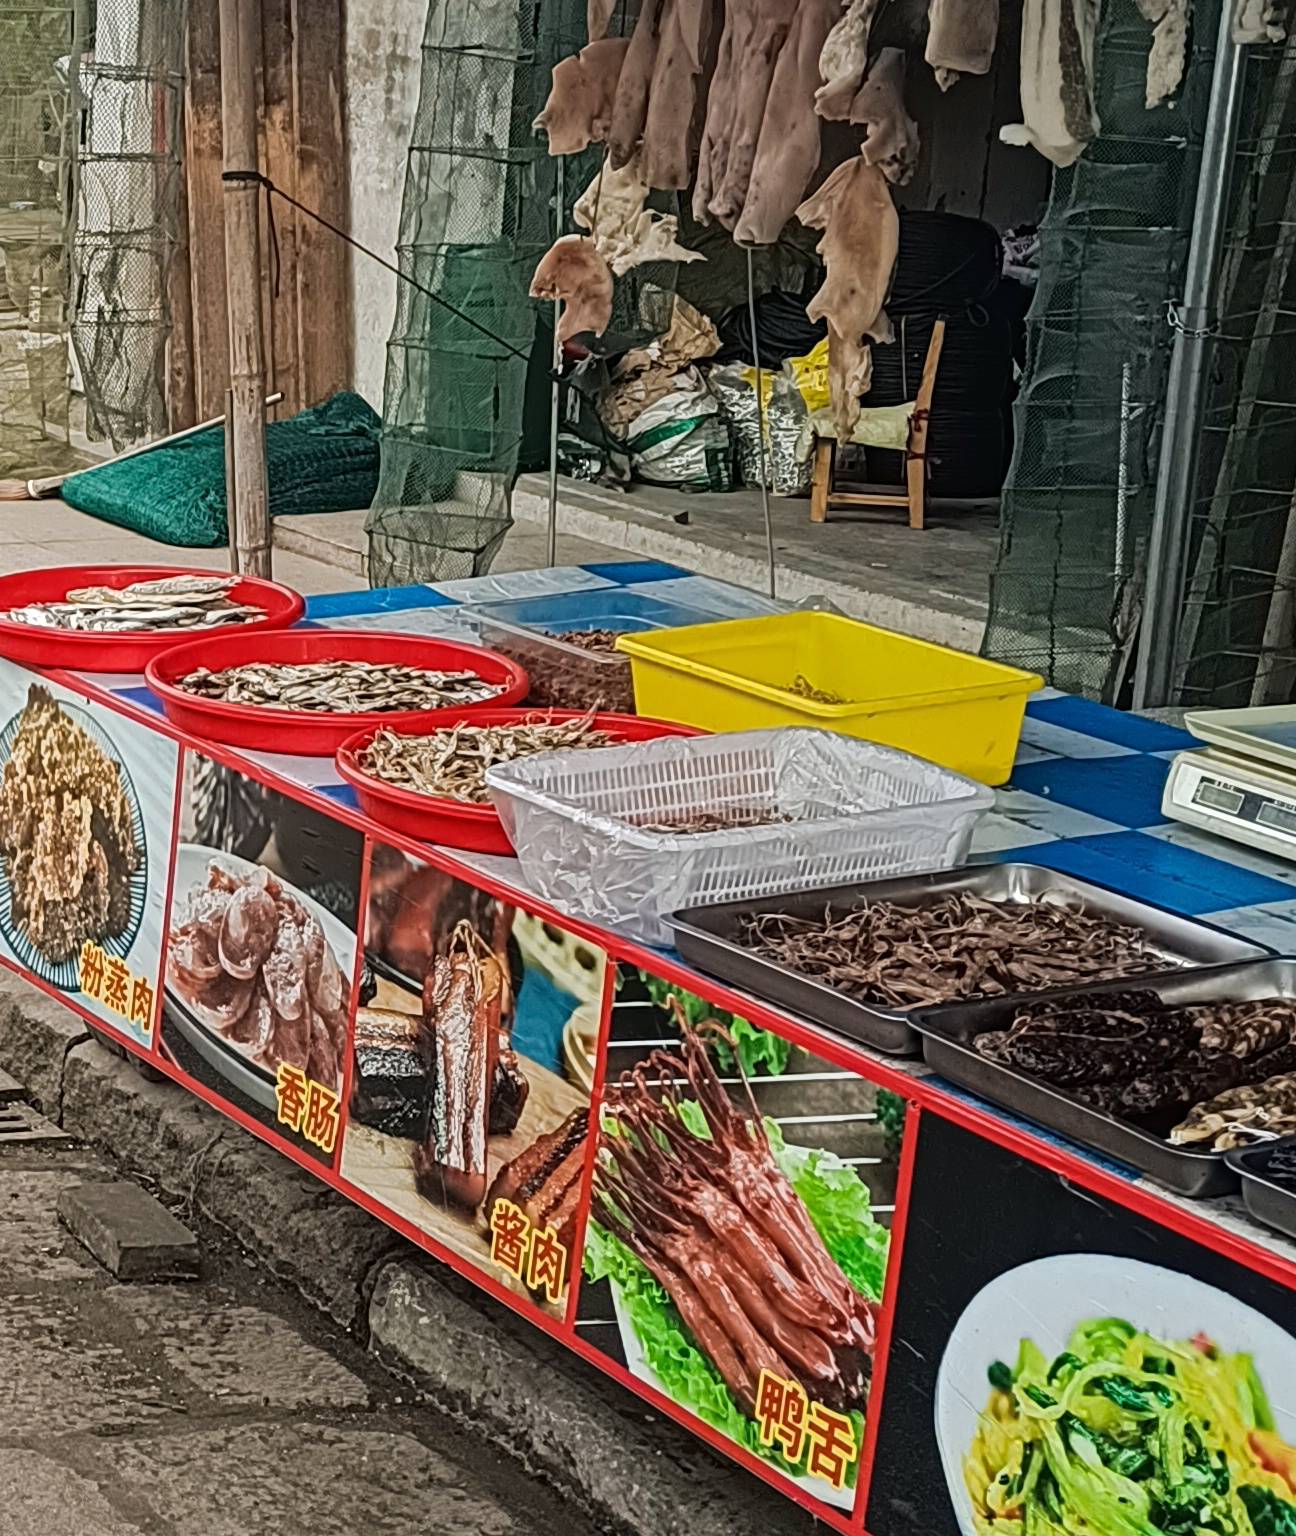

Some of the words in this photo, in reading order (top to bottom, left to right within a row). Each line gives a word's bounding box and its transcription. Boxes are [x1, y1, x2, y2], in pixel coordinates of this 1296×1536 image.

[80, 940, 156, 1031] 粉蒸肉
[275, 1063, 341, 1154] 香肠
[490, 1197, 567, 1304] 酱肉
[755, 1368, 857, 1490] 鸭舌
